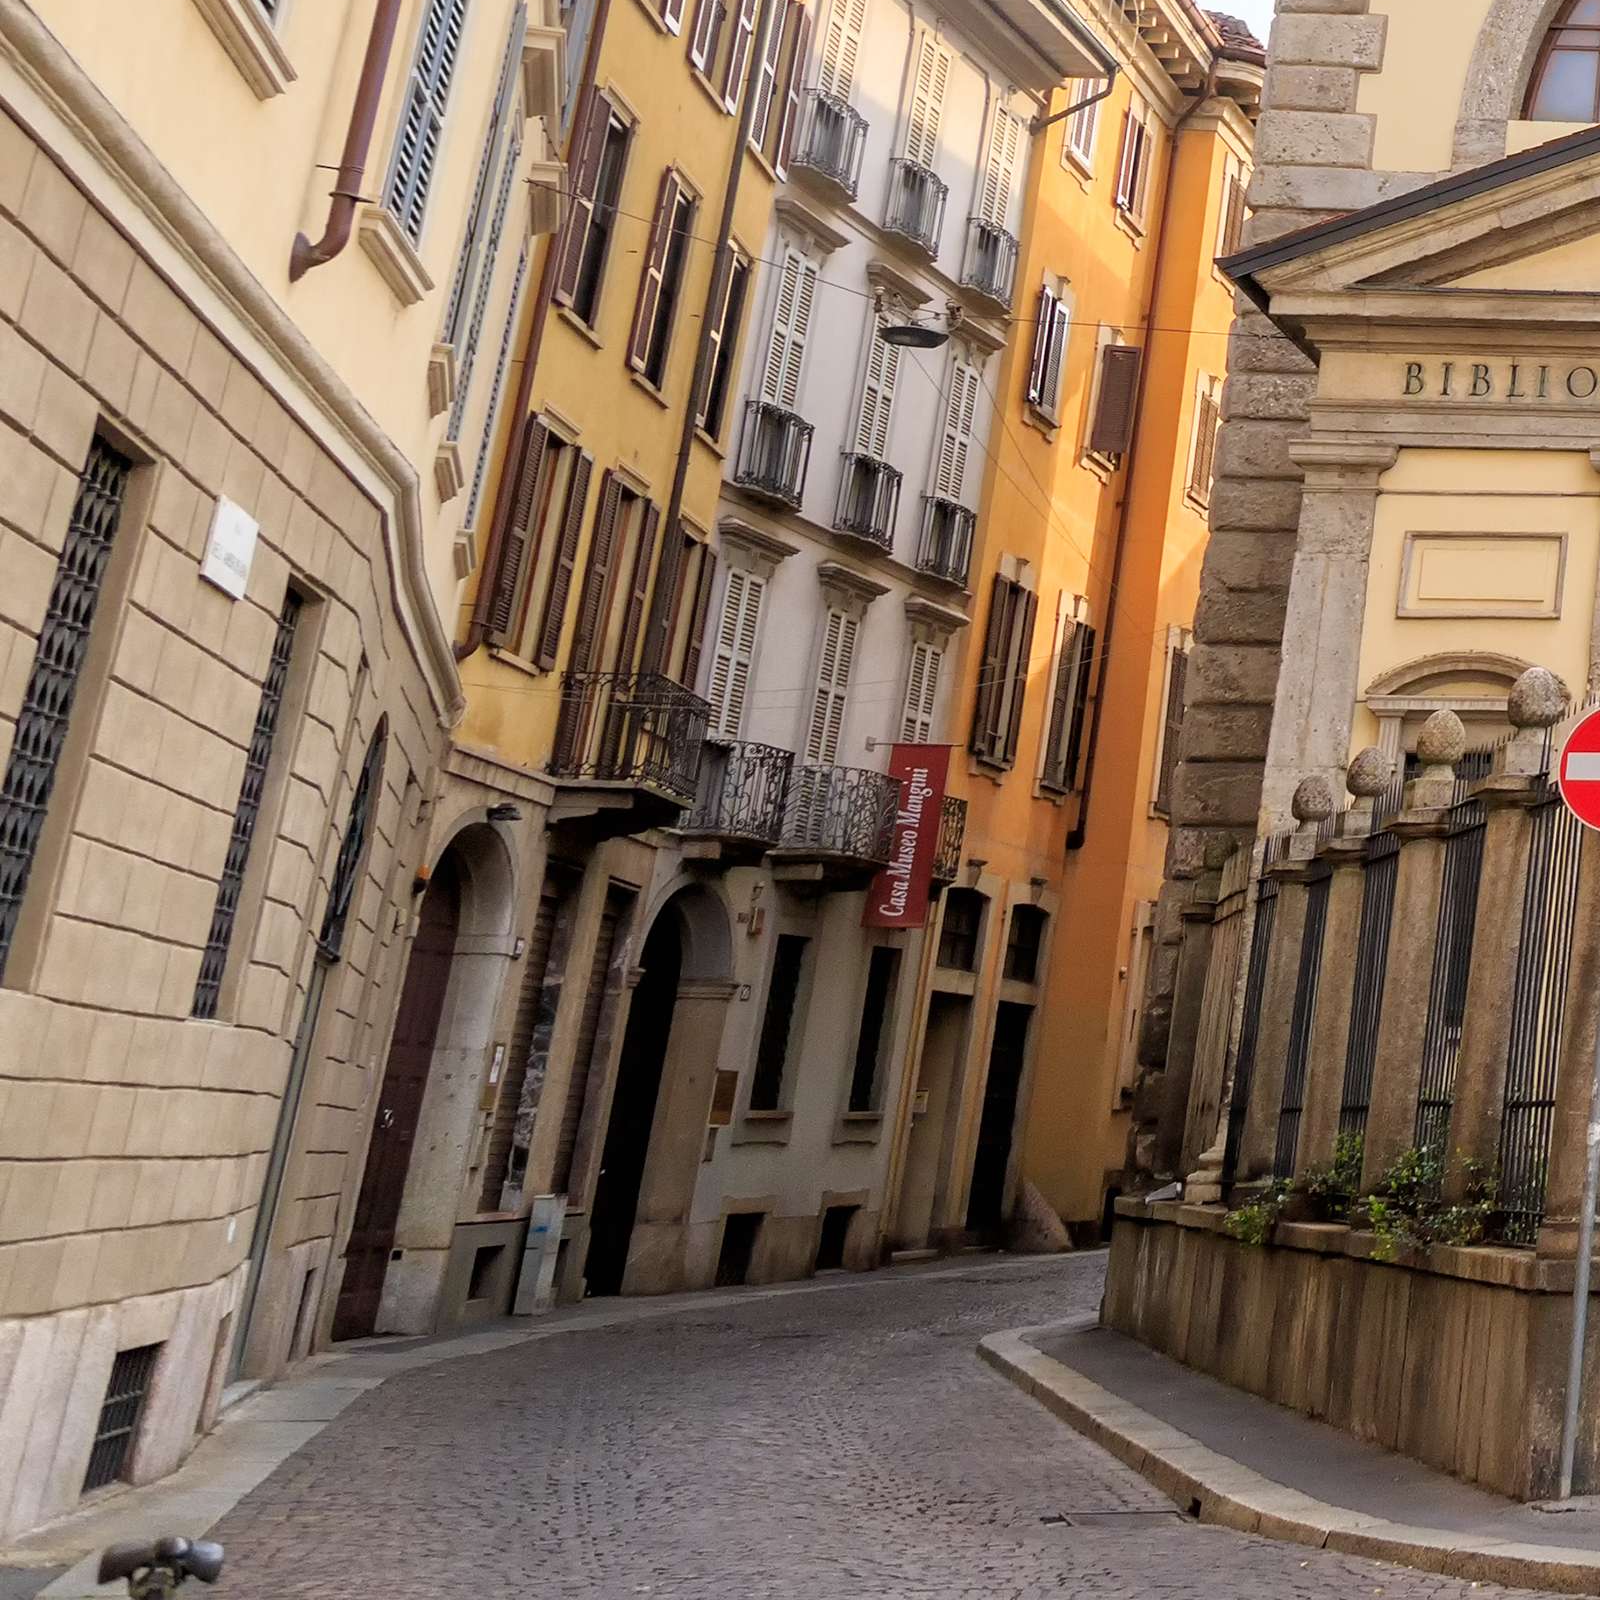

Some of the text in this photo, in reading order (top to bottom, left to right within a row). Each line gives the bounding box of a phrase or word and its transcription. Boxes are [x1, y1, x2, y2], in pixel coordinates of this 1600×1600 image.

[879, 767, 932, 917] Casa Museo Mangini
